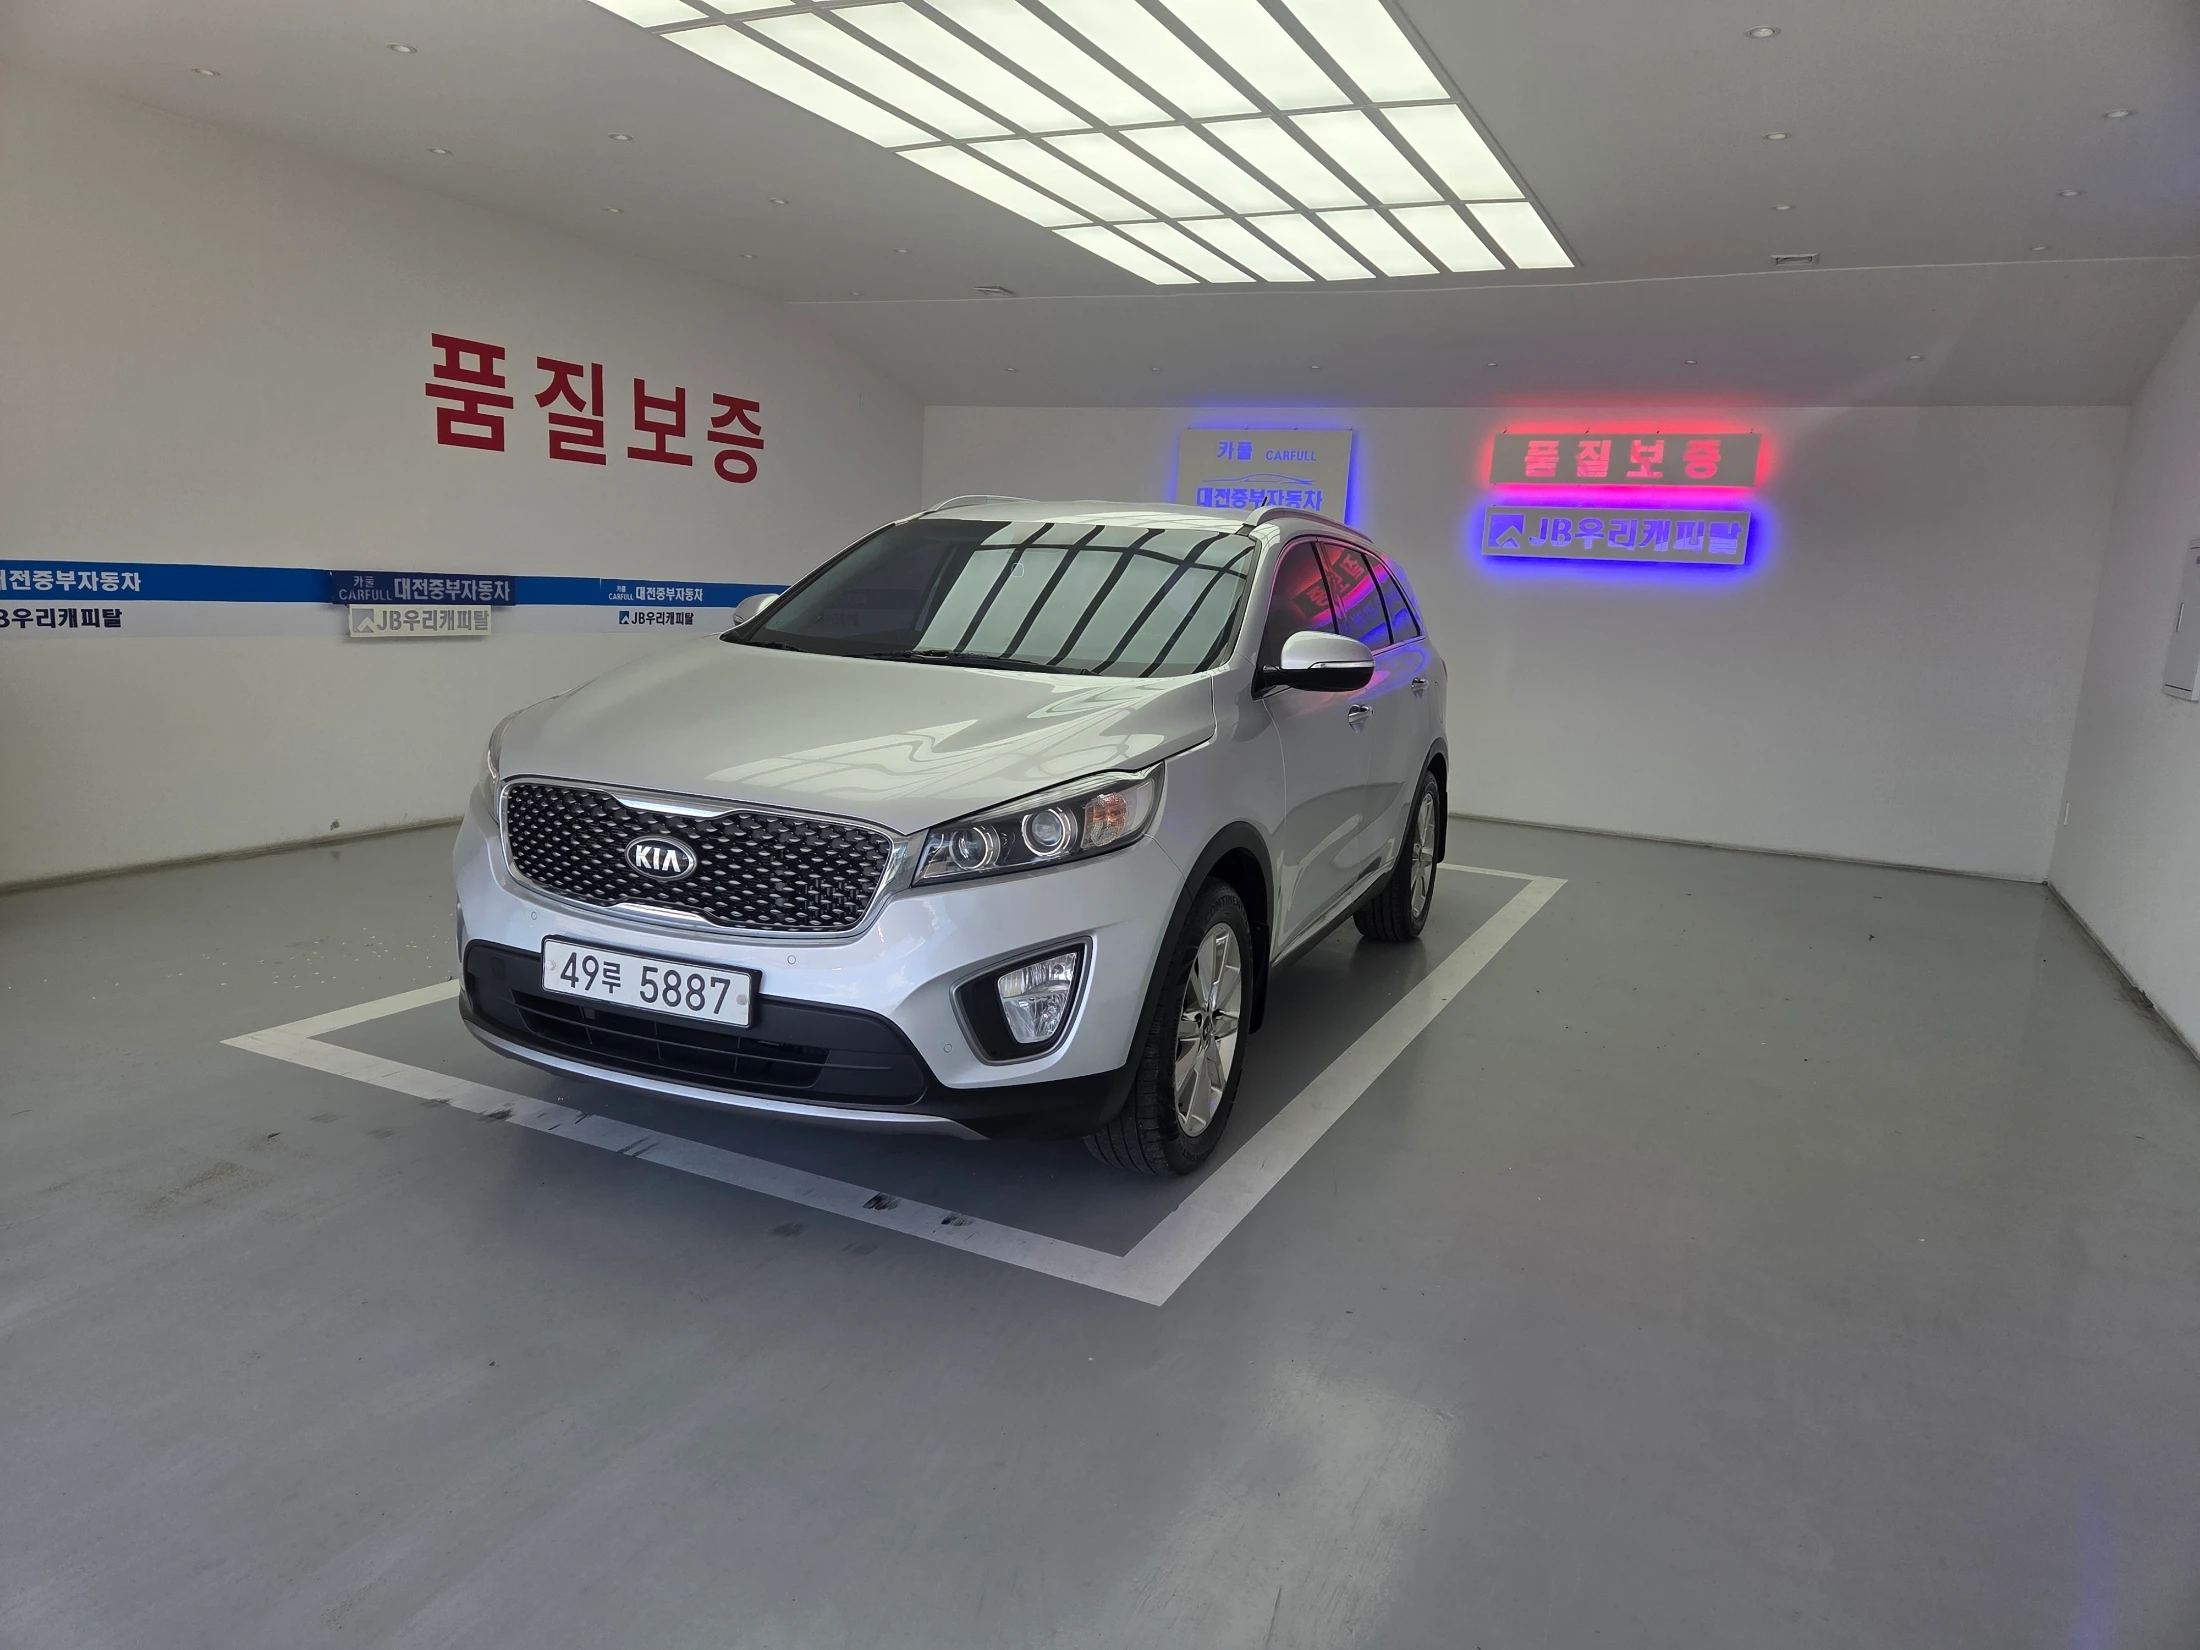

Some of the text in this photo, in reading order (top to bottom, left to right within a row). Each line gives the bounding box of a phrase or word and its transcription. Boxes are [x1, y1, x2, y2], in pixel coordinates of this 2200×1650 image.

[425, 332, 764, 484] 품질보증
[1265, 450, 1317, 462] CARFULL
[1524, 439, 1722, 479] 품질보증
[1196, 487, 1323, 512] 대전중부자동차
[1528, 516, 1744, 555] JB우리캐피탈
[338, 588, 393, 601] CARFULL
[394, 577, 511, 601] 대전중부자동차
[635, 586, 703, 602] 대전중부자동차
[376, 608, 490, 632] JB우리캐피탈
[631, 611, 695, 626] JB우리캐피탈
[634, 844, 682, 874] KIA
[560, 951, 732, 1016] 49루 5887
